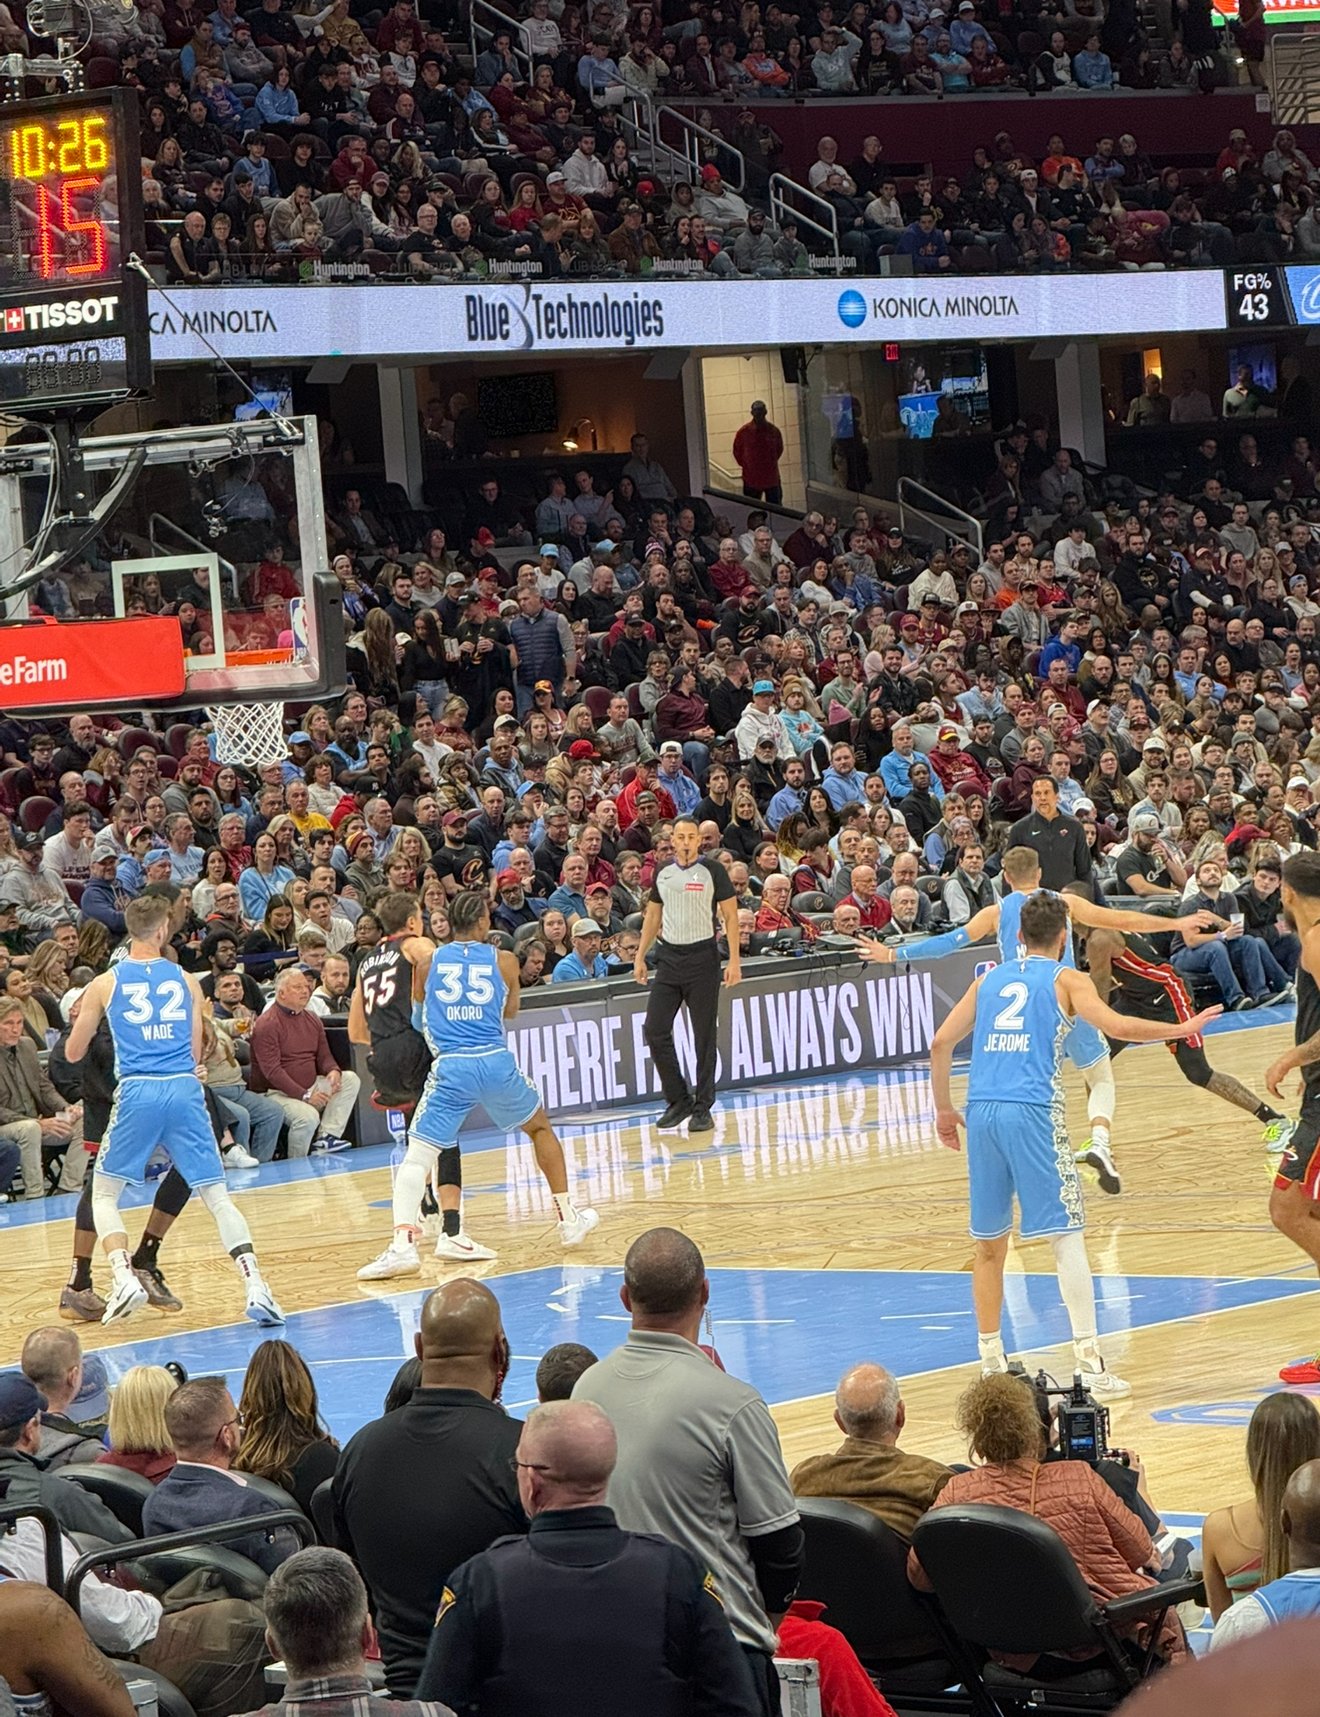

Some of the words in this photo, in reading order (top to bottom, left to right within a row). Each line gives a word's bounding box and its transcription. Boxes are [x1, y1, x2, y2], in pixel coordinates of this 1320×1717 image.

[11, 117, 107, 179] 10:26
[37, 177, 106, 279] 15
[313, 260, 371, 280] Huntington
[488, 257, 543, 277] Huntington
[652, 255, 704, 273] Huntington
[808, 252, 857, 270] Huntington
[1233, 272, 1272, 291] FG%
[24, 296, 119, 331] TISSOT
[464, 293, 511, 342] Blue
[531, 291, 664, 346] Technologies
[873, 297, 941, 319] KONICA
[945, 295, 1020, 317] MINOLTA
[1239, 293, 1269, 321] 43
[182, 310, 278, 334] MINOLTA
[0, 655, 68, 686] eFarm
[363, 967, 397, 1016] 55
[435, 963, 494, 1005] 35
[121, 980, 187, 1024] 32
[447, 1006, 483, 1021] OKORO
[994, 982, 1029, 1029] 2
[141, 1024, 175, 1041] WADE
[631, 1000, 723, 1096] FN
[731, 982, 862, 1081] ALWAYS
[865, 972, 935, 1059] WIN
[983, 1034, 1031, 1052] JEROME
